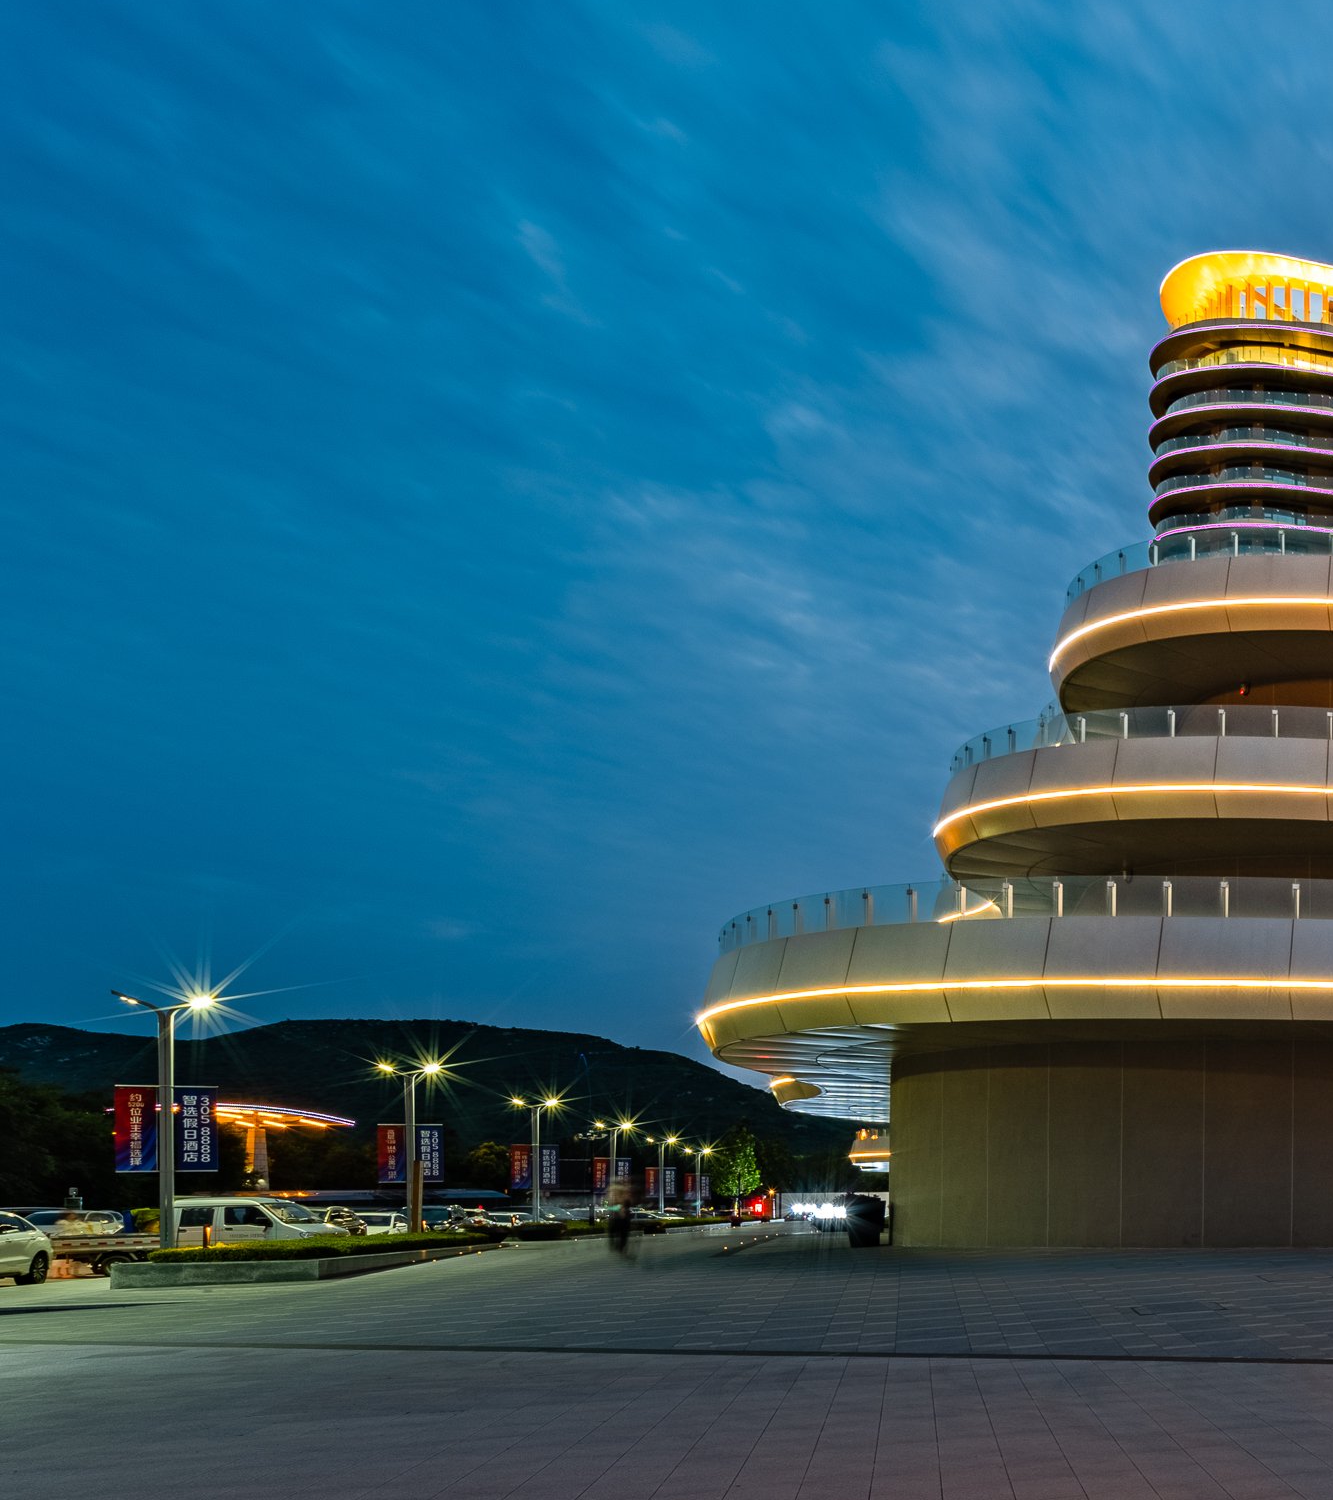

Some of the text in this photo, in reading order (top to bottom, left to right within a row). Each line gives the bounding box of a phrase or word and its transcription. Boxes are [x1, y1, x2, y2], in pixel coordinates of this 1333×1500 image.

[182, 1095, 199, 1162] 智选假日酒店
[200, 1097, 211, 1162] 305 8888
